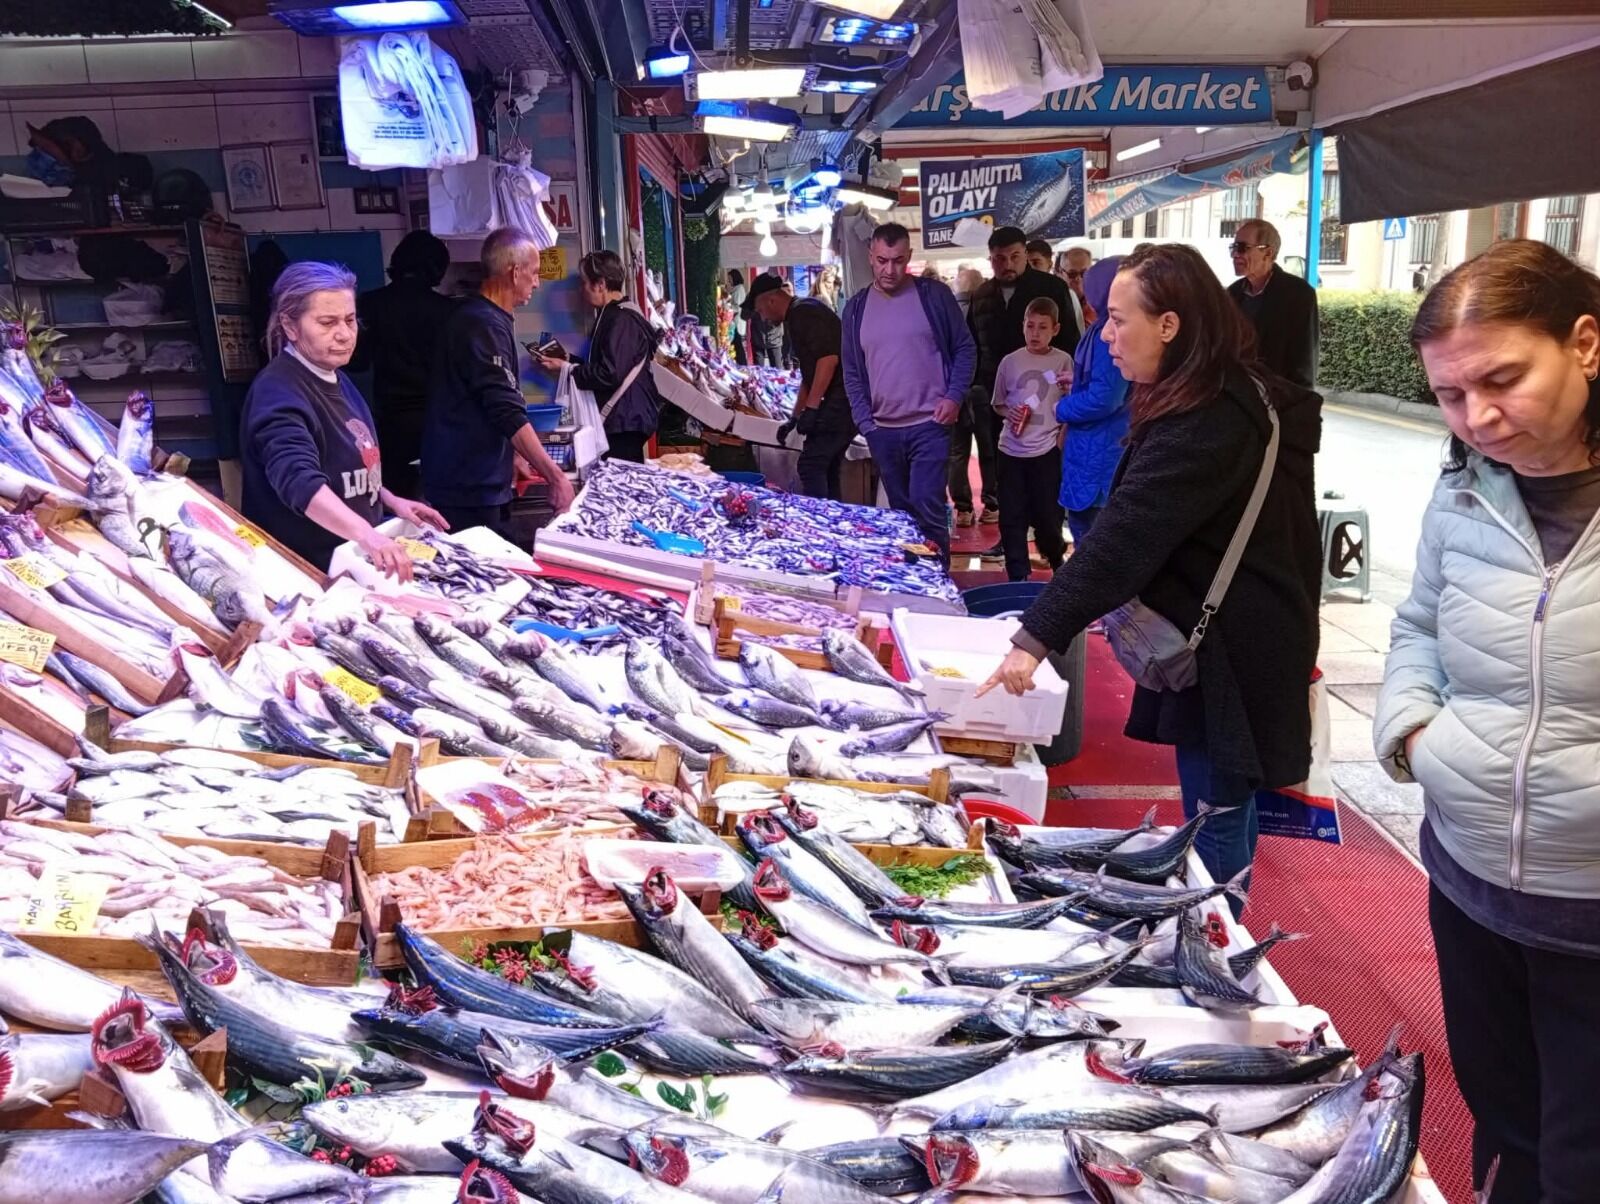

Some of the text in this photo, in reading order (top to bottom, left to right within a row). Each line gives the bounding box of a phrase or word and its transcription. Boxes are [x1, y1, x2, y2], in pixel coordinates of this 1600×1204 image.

[1109, 72, 1261, 111] Market
[927, 162, 1023, 197] PALAMUTTA
[928, 186, 999, 218] OLAY!
[928, 228, 953, 245] TANE
